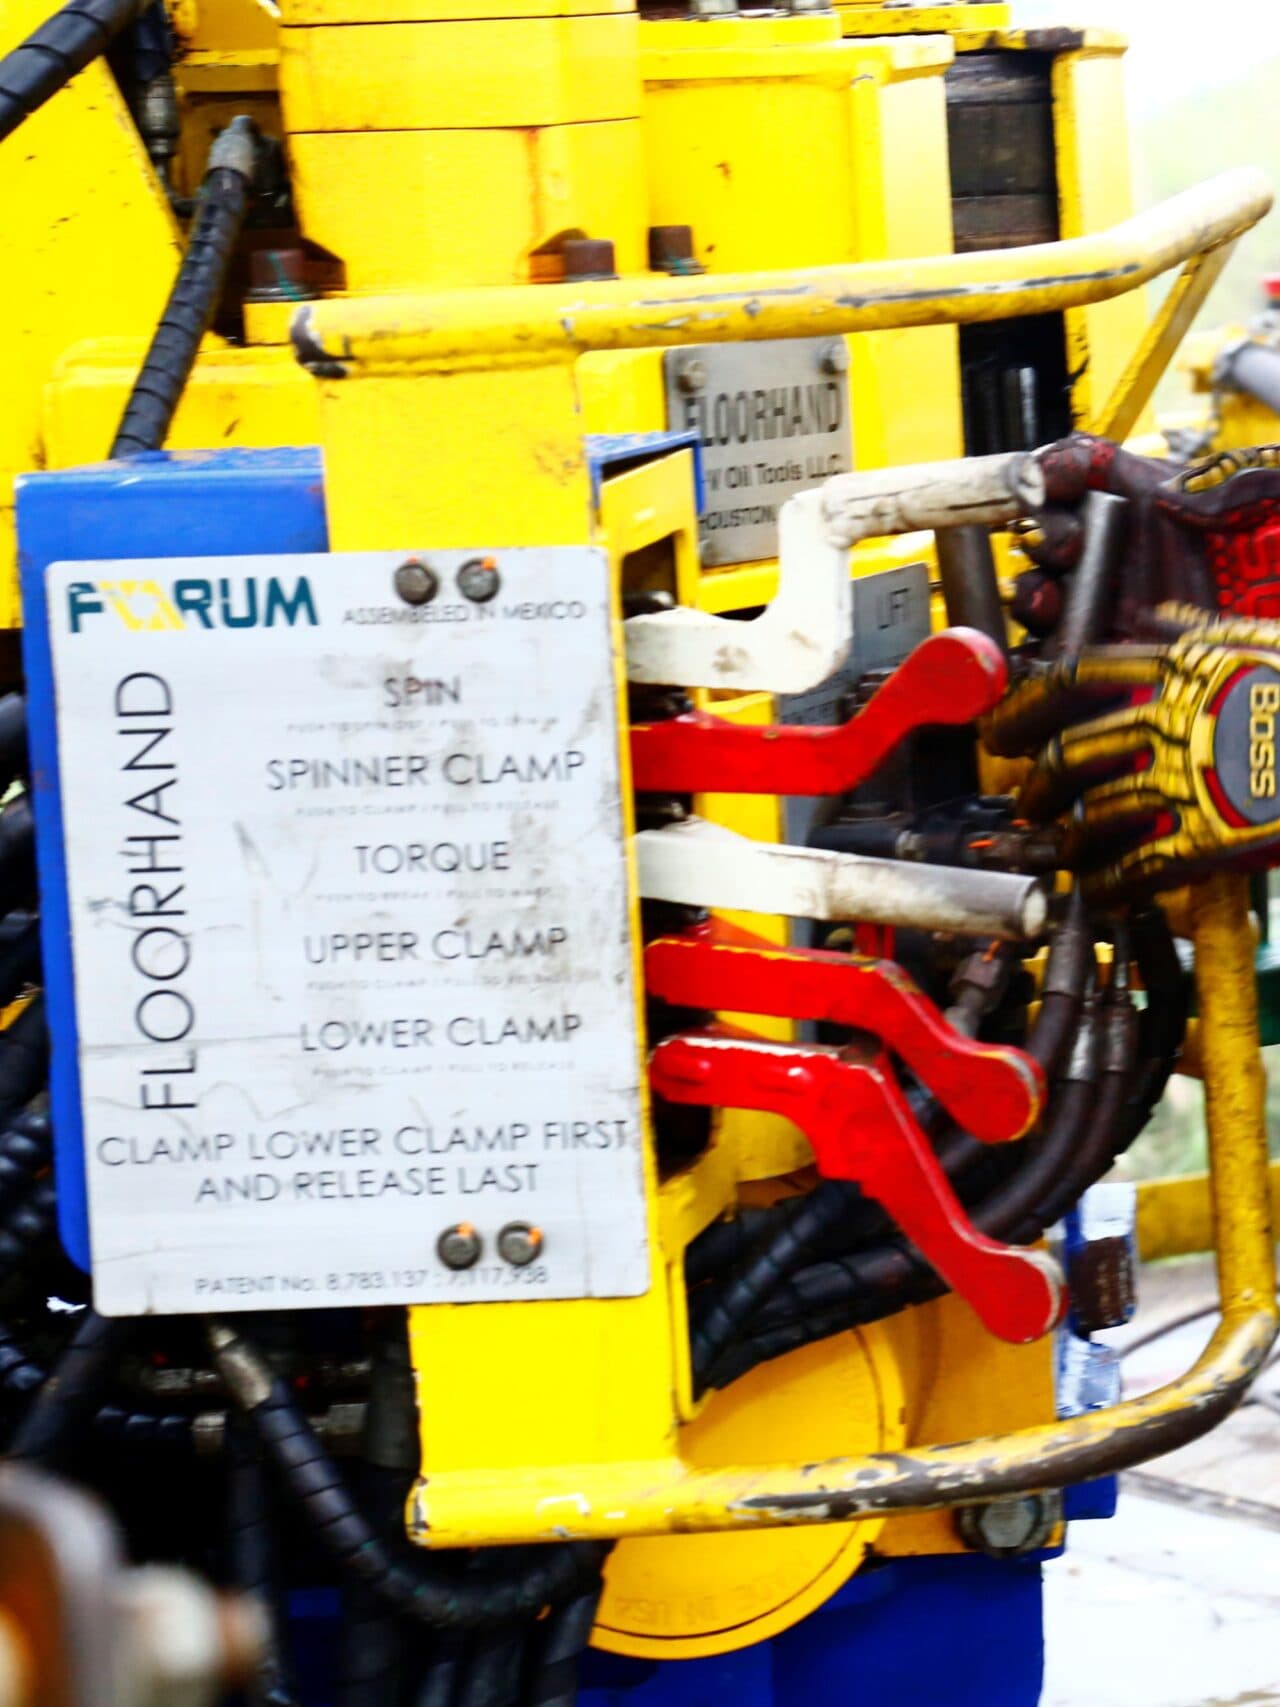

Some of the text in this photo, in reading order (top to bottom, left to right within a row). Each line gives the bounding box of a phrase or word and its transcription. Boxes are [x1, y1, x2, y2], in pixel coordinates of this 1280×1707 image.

[684, 381, 842, 447] FLOORHAND
[726, 464, 751, 488] Oil
[755, 458, 802, 485] Tools
[67, 575, 320, 634] FORUM
[503, 600, 587, 620] MEXICO
[383, 676, 462, 708] SPIN
[266, 751, 586, 791] SPINNER CLAMP
[354, 842, 511, 875] TORQUE
[114, 671, 198, 1110] FLOORHAND
[304, 927, 567, 964] UPPER CLAMP
[300, 1013, 582, 1051] LOWER CLAMP
[97, 1120, 627, 1167] CLAMP LOWER CLAMP FIRST
[195, 1163, 540, 1203] AND RELEASE LAST
[195, 1275, 276, 1296] PATENT
